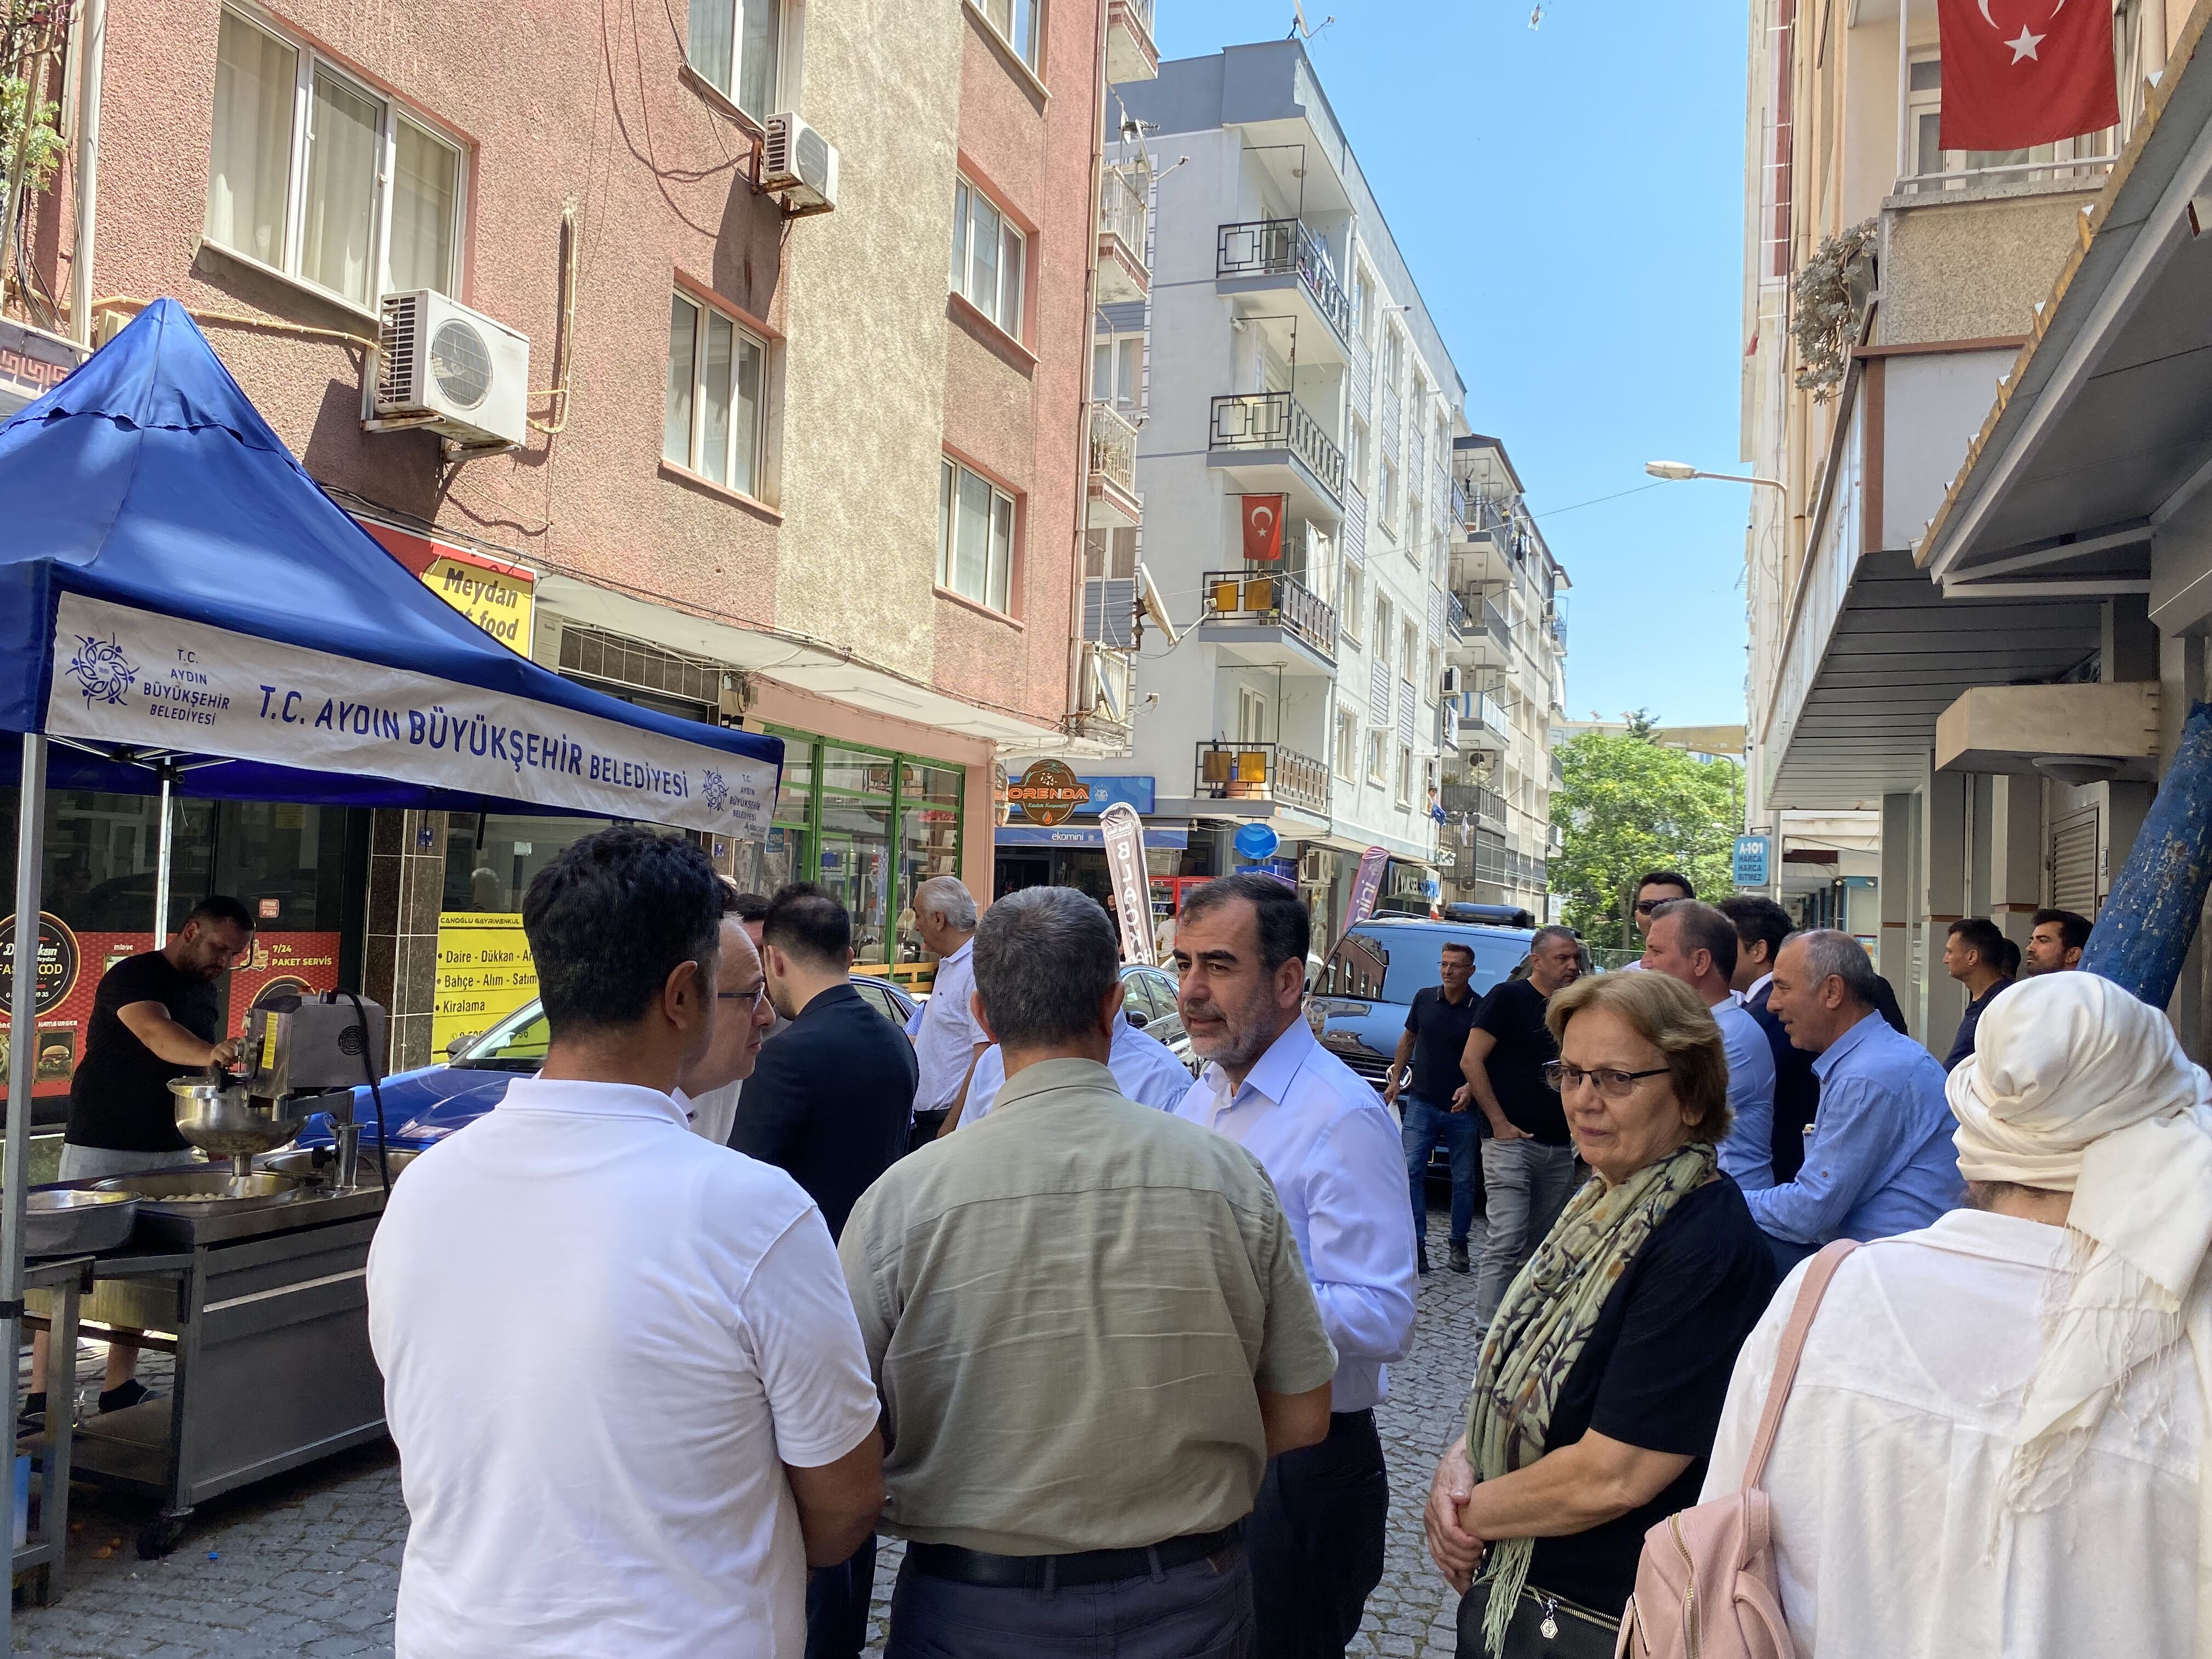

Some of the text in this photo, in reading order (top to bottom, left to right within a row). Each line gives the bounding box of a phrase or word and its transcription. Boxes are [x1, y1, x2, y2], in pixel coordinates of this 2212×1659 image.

[443, 567, 518, 608] Meydan
[479, 611, 519, 641] food
[177, 649, 198, 664] T.C.
[171, 668, 207, 685] AYDIN
[144, 681, 230, 710] BÜYÜKŞEHİR
[150, 704, 217, 726] BELEDİYESİ
[259, 684, 689, 798] T.C. AYDIN BÜYÜKŞEHİR BELEDİYESİ
[741, 786, 755, 796] AYDIN
[1008, 788, 1090, 799] ORENDA
[1052, 831, 1084, 841] ekomini
[1739, 842, 1764, 854] A-101
[272, 943, 292, 953] 7/24
[272, 955, 332, 966] PAKET SERVİS
[447, 951, 471, 963] Daire
[481, 950, 514, 963] Dükkan
[522, 950, 532, 961] Ar
[37, 964, 63, 975] OOD
[445, 975, 474, 990] Bahçe
[483, 974, 503, 986] Alım
[512, 973, 537, 985] Satım
[443, 1000, 486, 1013] Kiralama
